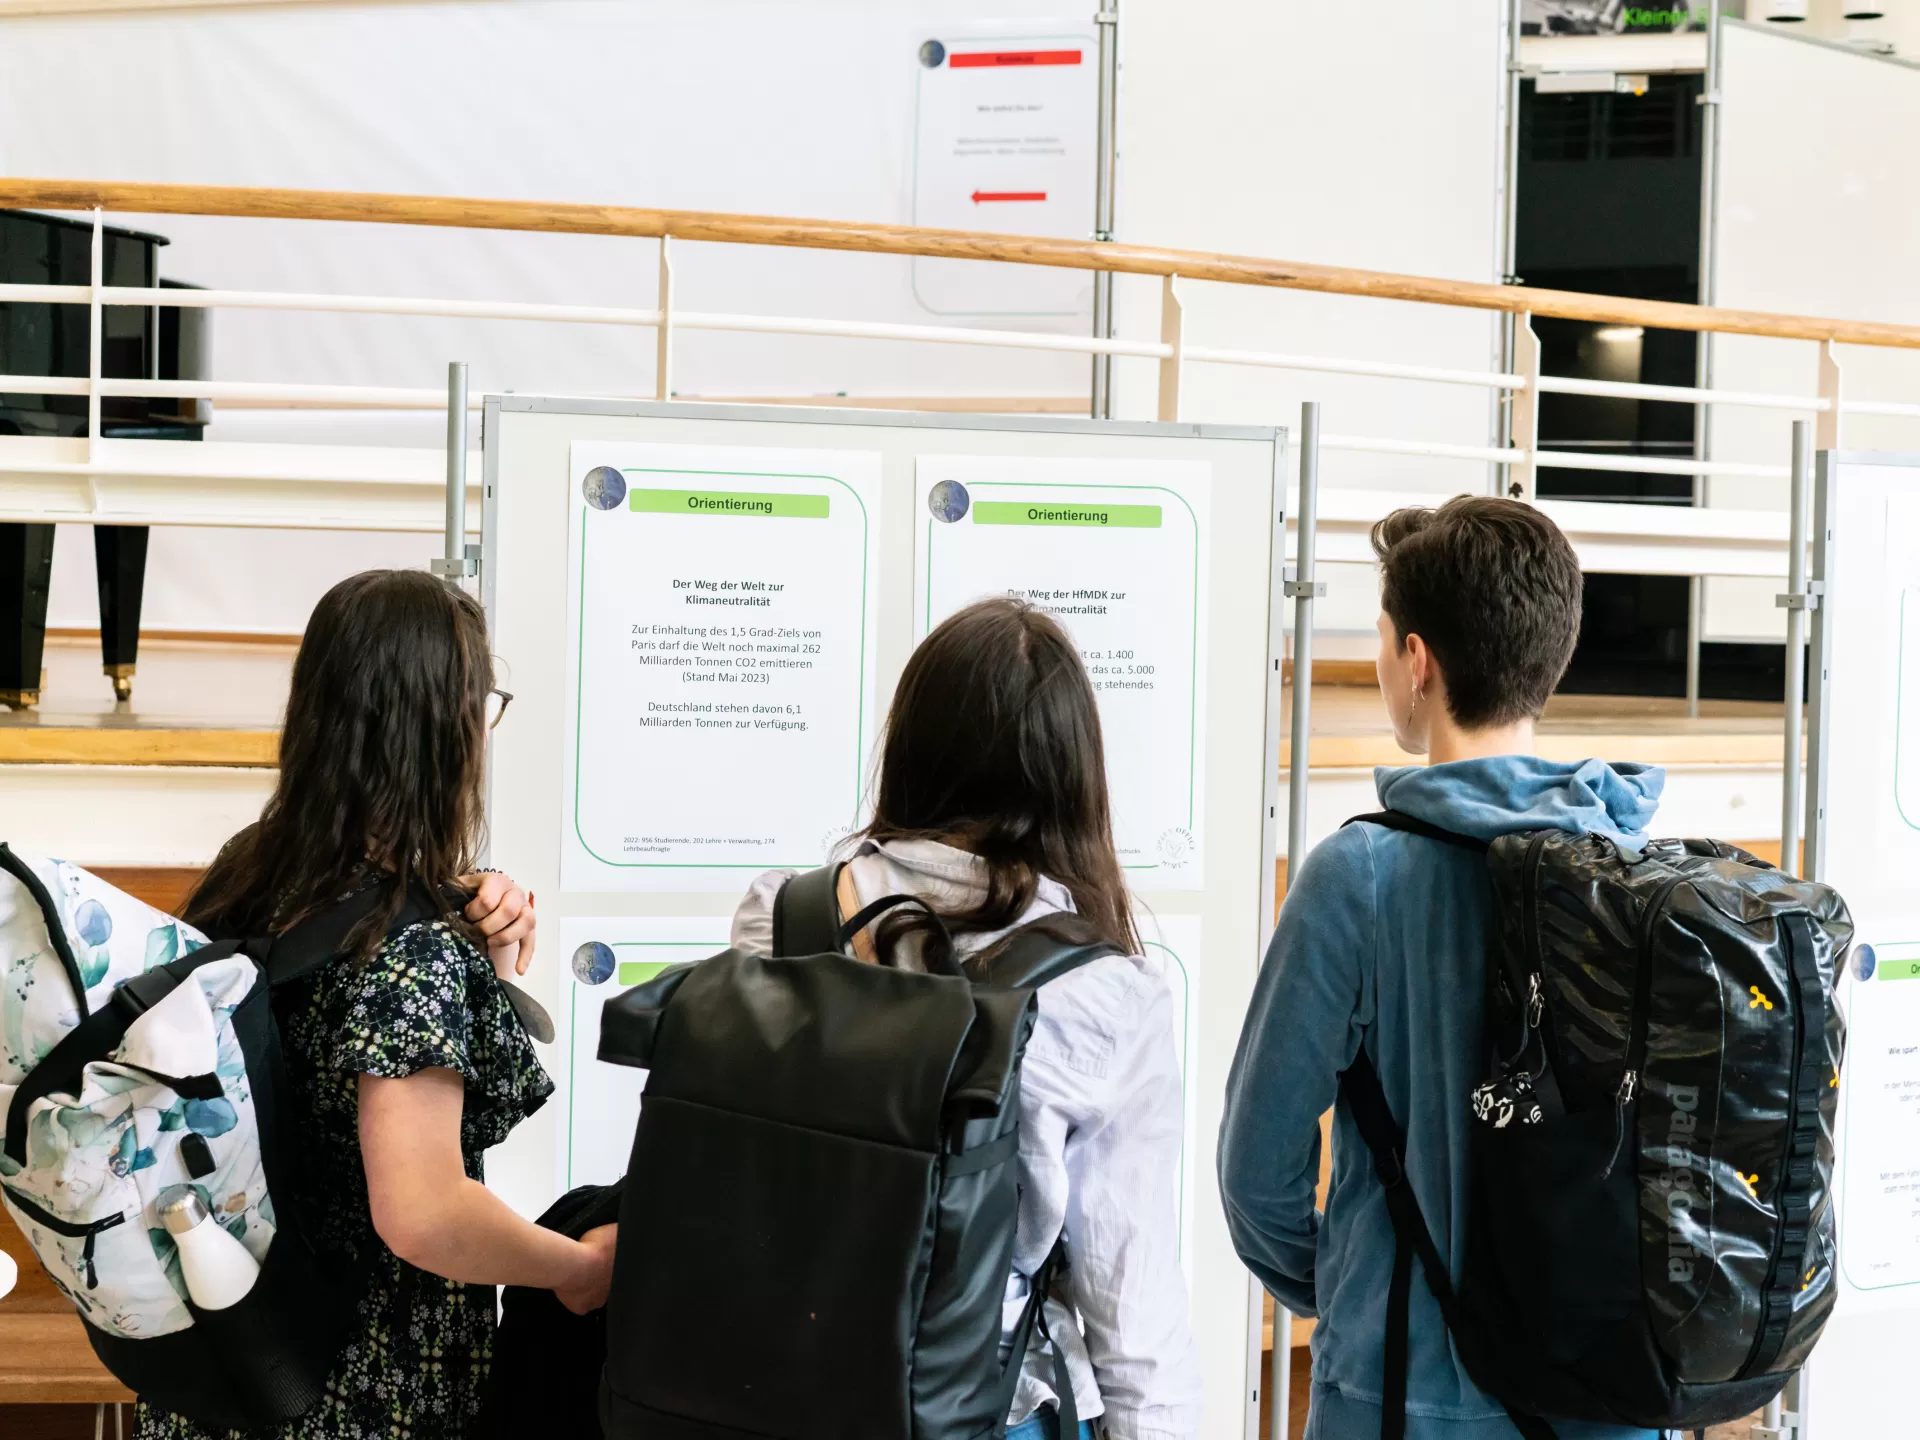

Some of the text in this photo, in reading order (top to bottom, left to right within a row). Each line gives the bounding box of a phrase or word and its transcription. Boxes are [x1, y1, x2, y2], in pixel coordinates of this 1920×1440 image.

[1624, 8, 1688, 25] Kleiner
[688, 497, 772, 513] Orientierung
[1028, 508, 1108, 524] Orientierung
[673, 580, 691, 588] Der
[695, 580, 717, 591] Weg
[721, 581, 738, 590] der
[741, 582, 765, 590] Welt
[1008, 588, 1025, 598] Der
[1028, 590, 1050, 600] Weg
[1053, 590, 1069, 598] der
[1073, 590, 1107, 599] HfMDK
[686, 595, 770, 606] Klimaneutralität
[632, 625, 648, 633] Zur
[653, 625, 706, 637] Einhaltung
[710, 627, 727, 636] des
[732, 627, 746, 637] 1,5
[749, 628, 800, 637] Grad-Ziels
[632, 640, 820, 653] Paris darf die Welt noch maximal 262
[1108, 650, 1133, 659] 1.400
[640, 656, 812, 668] Milliarden Tonnen CO2 emittieren
[1092, 665, 1108, 674] das
[1128, 665, 1154, 674] 5.000
[683, 672, 769, 684] (Stand Mai 2023)
[1105, 680, 1153, 689] stehendes
[649, 702, 801, 715] Deutschland stehen davon 6,1
[640, 717, 691, 727] Milliarden
[695, 718, 732, 728] Tonnen
[754, 719, 808, 731] Verfügung.
[1659, 1083, 1701, 1283] patagonia
